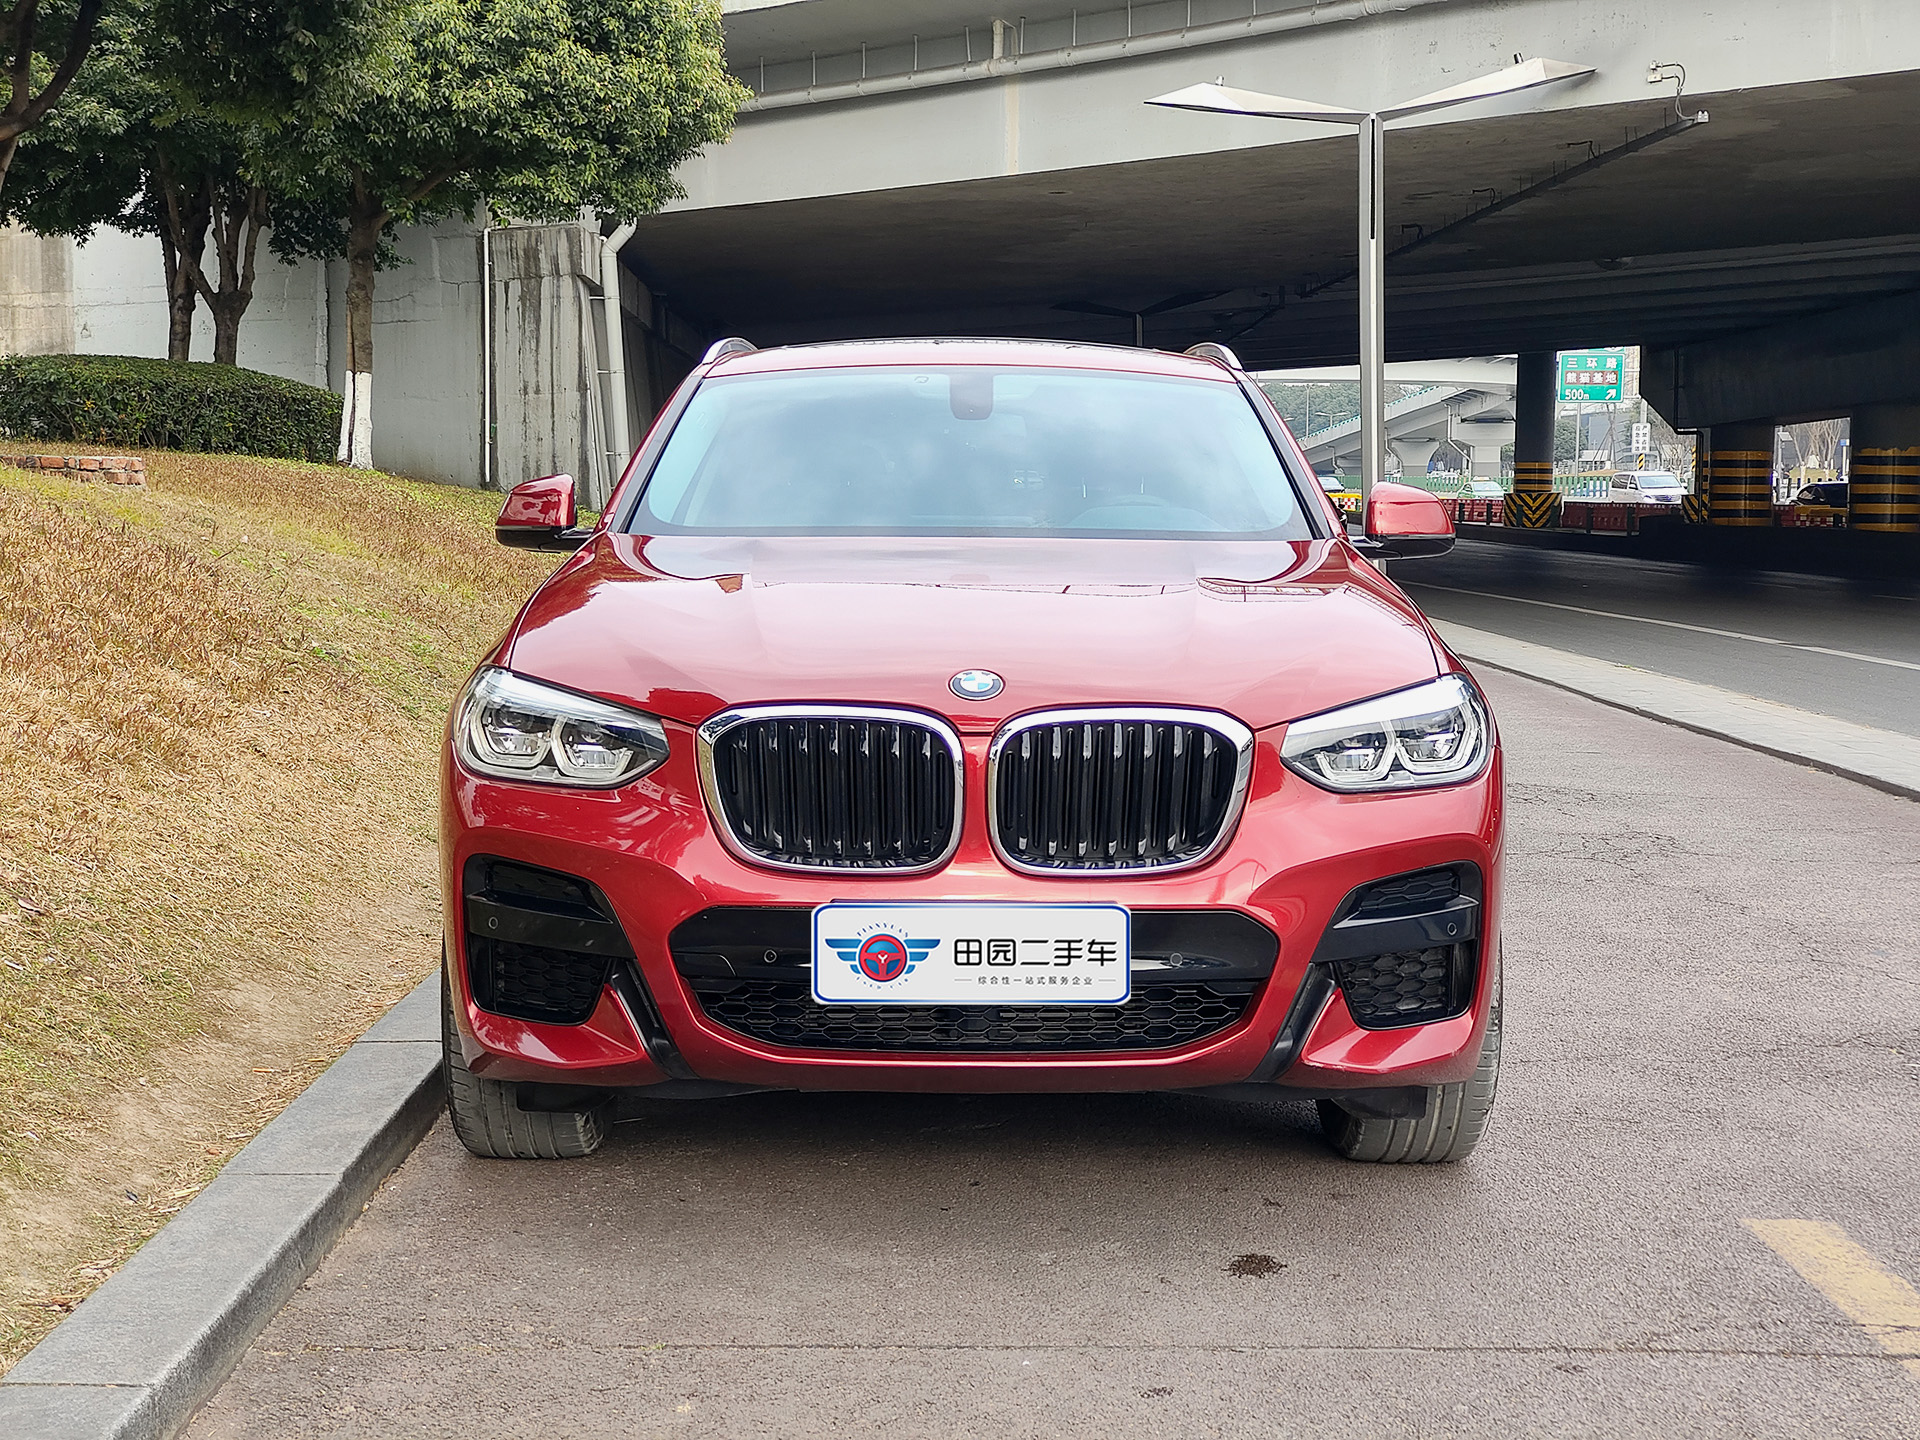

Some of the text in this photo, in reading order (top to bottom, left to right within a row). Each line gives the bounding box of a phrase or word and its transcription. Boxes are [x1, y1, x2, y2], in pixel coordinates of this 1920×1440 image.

[1567, 357, 1617, 369] 三环路
[1566, 372, 1617, 384] 熊猫基地
[1565, 389, 1589, 400] 500m
[954, 938, 1117, 967] 田园二手车
[978, 975, 1093, 986] 综合性一站式服务企业
